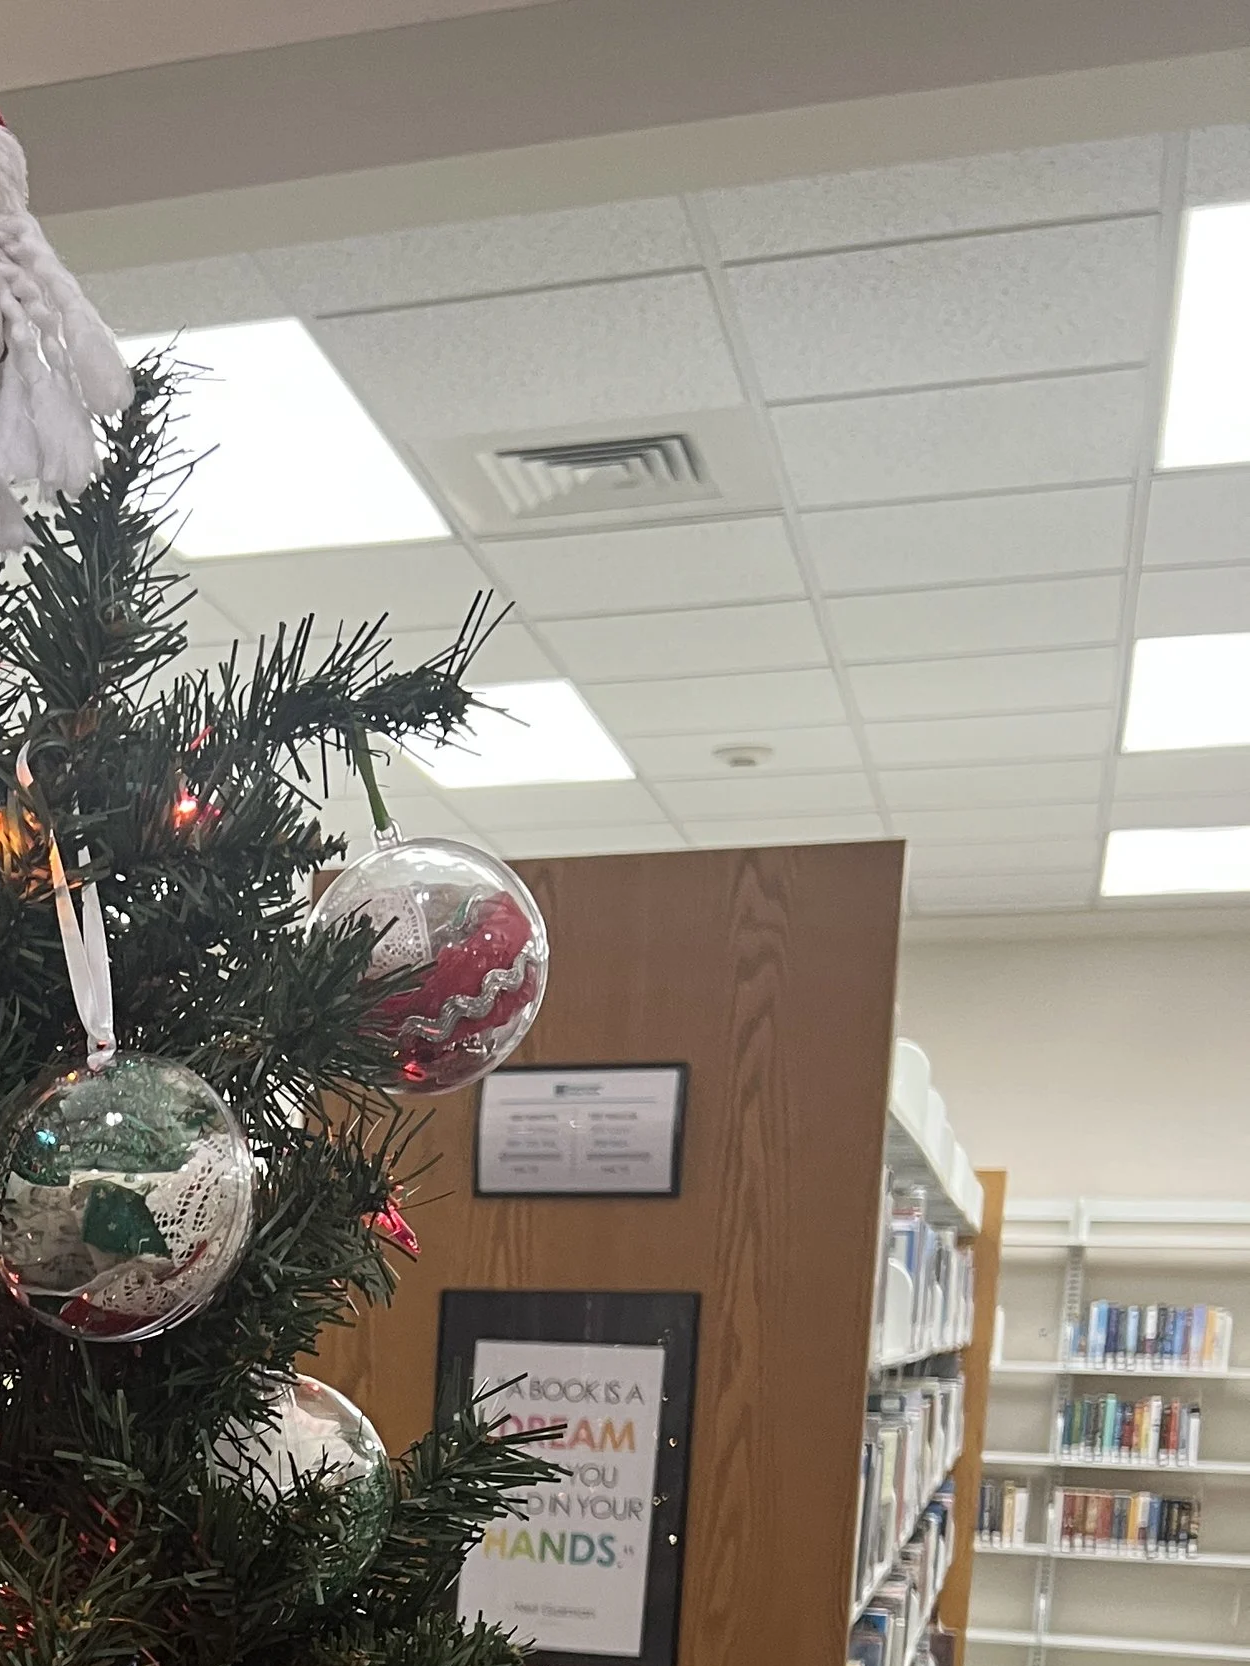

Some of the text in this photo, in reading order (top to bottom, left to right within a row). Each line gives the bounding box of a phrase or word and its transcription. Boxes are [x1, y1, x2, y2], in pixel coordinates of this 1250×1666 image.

[529, 1377, 600, 1403] BOOK
[605, 1380, 622, 1405] IS
[626, 1382, 645, 1405] A
[567, 1463, 619, 1489] YOU
[549, 1493, 571, 1517] IN
[576, 1495, 645, 1521] YOUR
